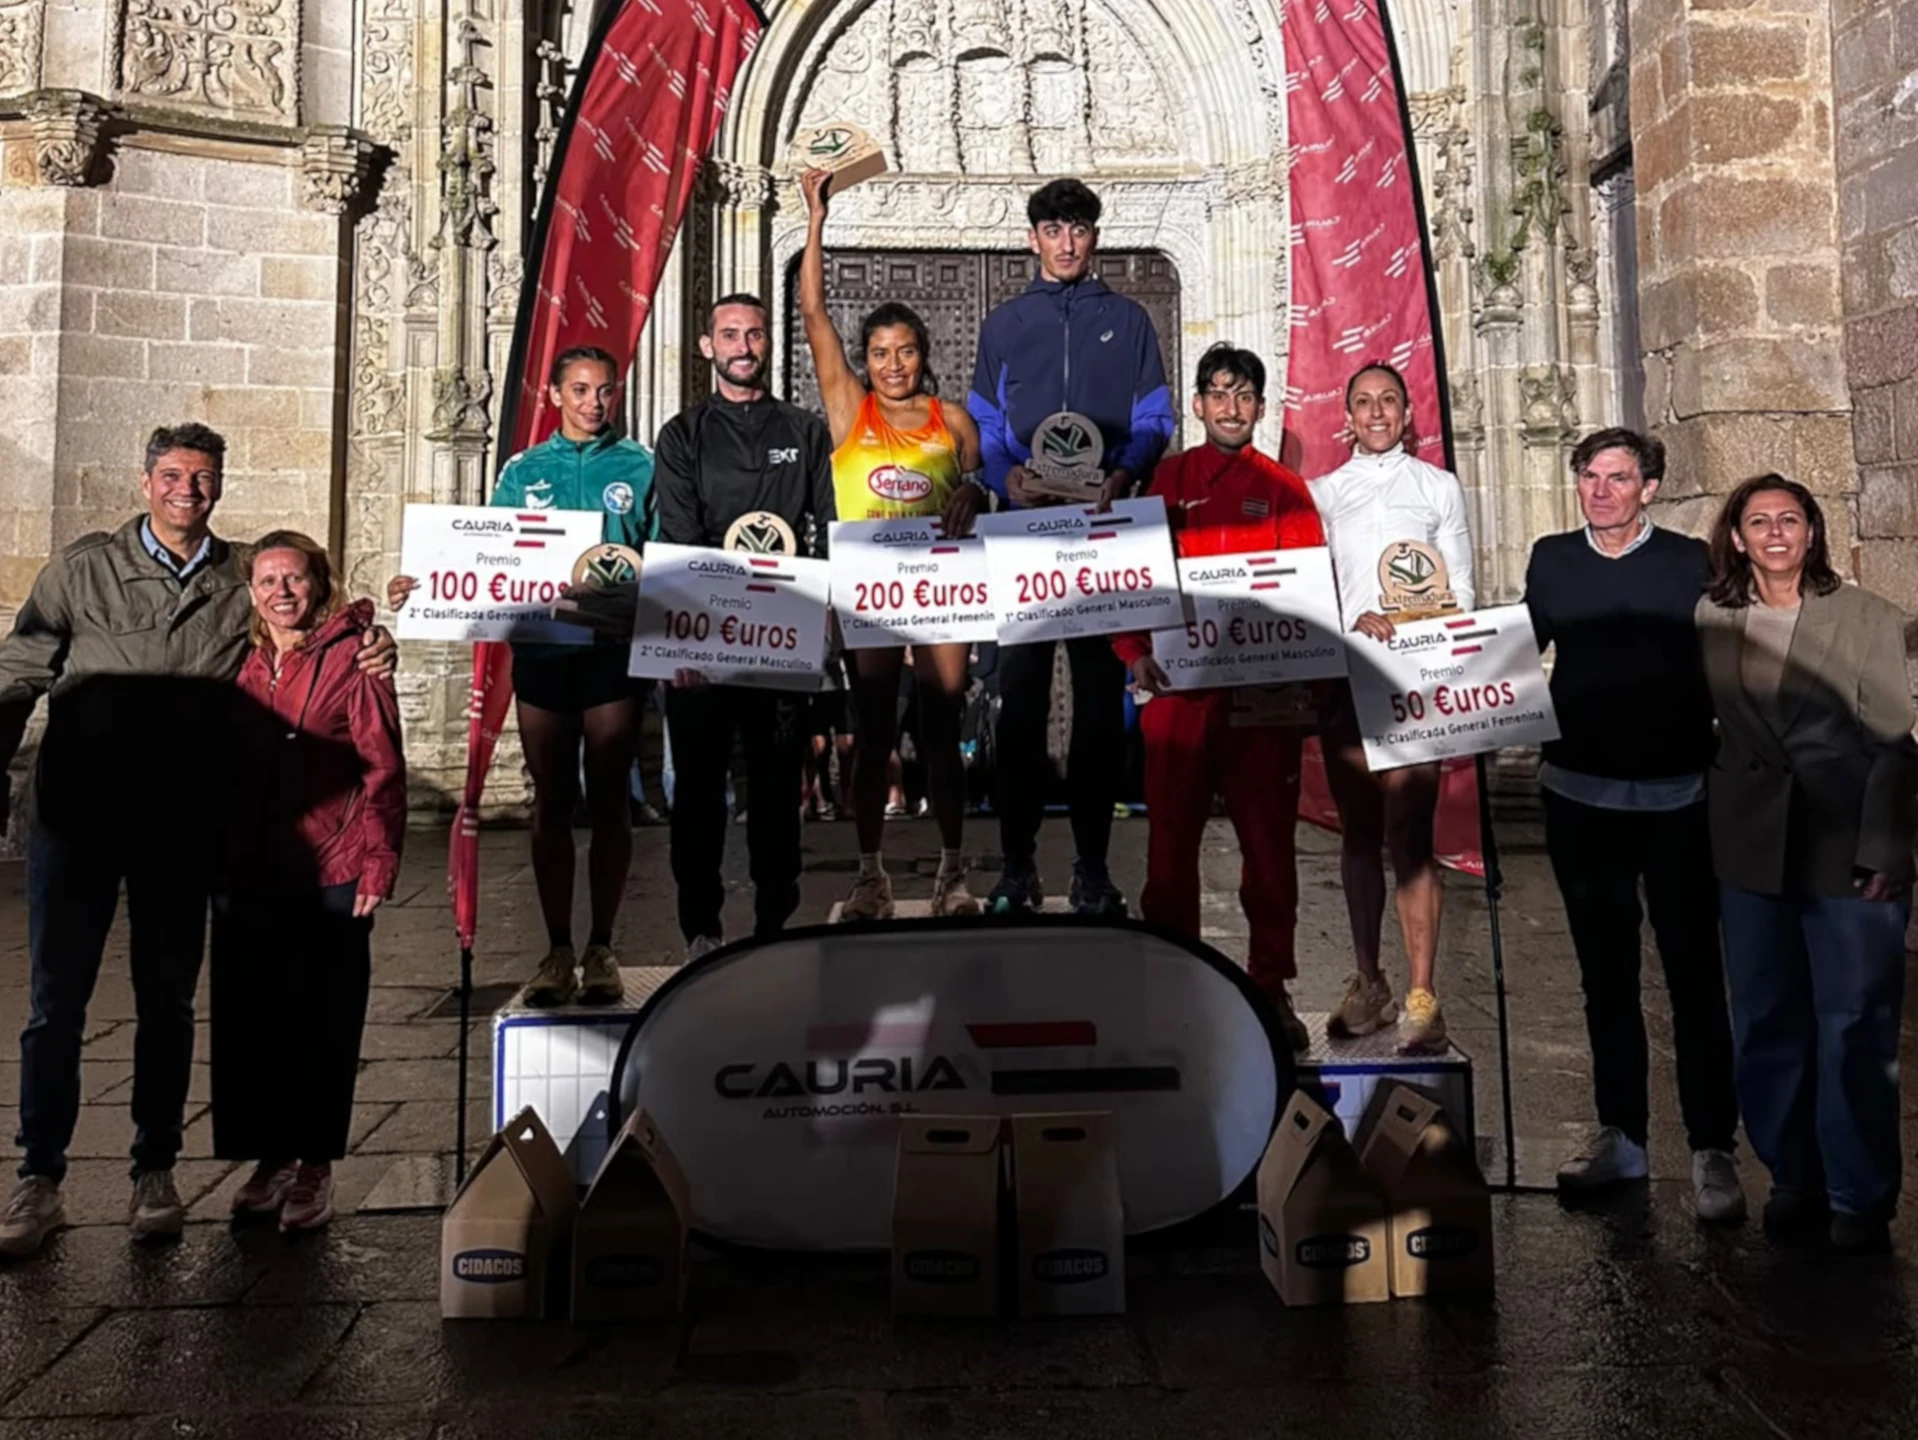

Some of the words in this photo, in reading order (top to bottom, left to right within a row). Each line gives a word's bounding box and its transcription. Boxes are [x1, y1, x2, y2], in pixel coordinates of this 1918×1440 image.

[452, 520, 513, 532] CAURIA
[1027, 517, 1085, 533] CAURIA
[872, 531, 930, 543] CAURIA
[476, 552, 521, 566] Premio
[1056, 549, 1098, 562] Premio
[688, 560, 747, 576] CAURIA
[897, 562, 939, 574] Premio
[1188, 567, 1247, 581] CAURIA
[430, 571, 478, 601] 100
[1015, 570, 1067, 603] 200
[1075, 566, 1153, 596] €uros
[709, 594, 752, 610] Premio
[855, 580, 904, 612] 200
[913, 579, 988, 608] €uros
[1218, 598, 1261, 612] Premio
[423, 608, 484, 620] Clasificada
[487, 609, 530, 621] General
[1017, 607, 1074, 622] Clasificado
[1077, 601, 1117, 614] General
[1119, 595, 1172, 610] Masculino
[852, 616, 908, 629] Clasificada
[911, 614, 949, 627] General
[952, 610, 996, 622] Femenin
[664, 610, 710, 641] 100
[719, 615, 798, 650] €uros
[1187, 619, 1219, 649] 50
[1229, 617, 1307, 646] €uros
[1387, 632, 1447, 651] CAURIA
[654, 647, 714, 662] Clasificado
[717, 651, 757, 665] General
[760, 655, 813, 670] Masculino
[1178, 654, 1235, 669] Clasificado
[1238, 651, 1279, 664] General
[1282, 647, 1336, 660] Masculino
[1420, 665, 1464, 681] Premio
[1390, 690, 1425, 723] 50
[1434, 681, 1515, 716] €uros
[1387, 728, 1445, 745] Clasificada
[1448, 720, 1490, 735] General
[1492, 710, 1544, 724] Femenina
[715, 1055, 967, 1098] CAURIA
[457, 1256, 522, 1277] CIDACOS
